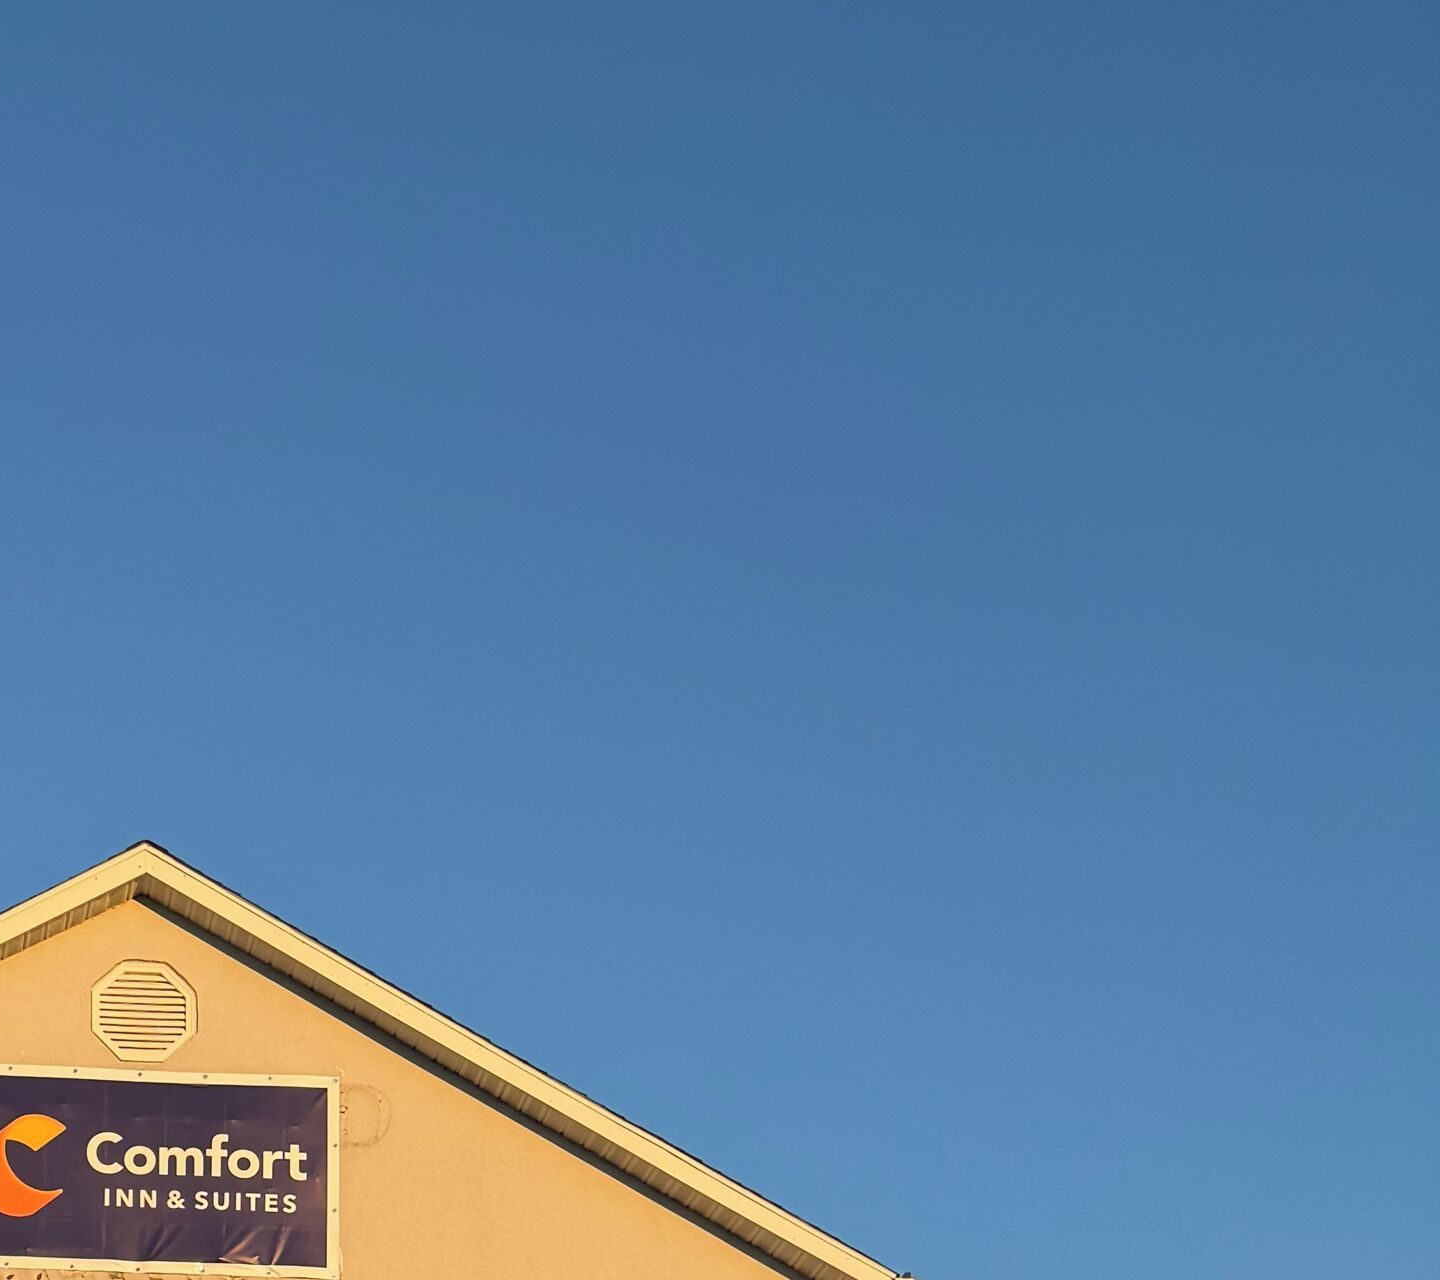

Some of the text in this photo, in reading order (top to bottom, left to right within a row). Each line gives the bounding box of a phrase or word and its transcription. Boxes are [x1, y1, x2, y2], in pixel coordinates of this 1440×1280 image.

[86, 1131, 308, 1181] Comfort
[103, 1188, 297, 1214] INN & SUITES
